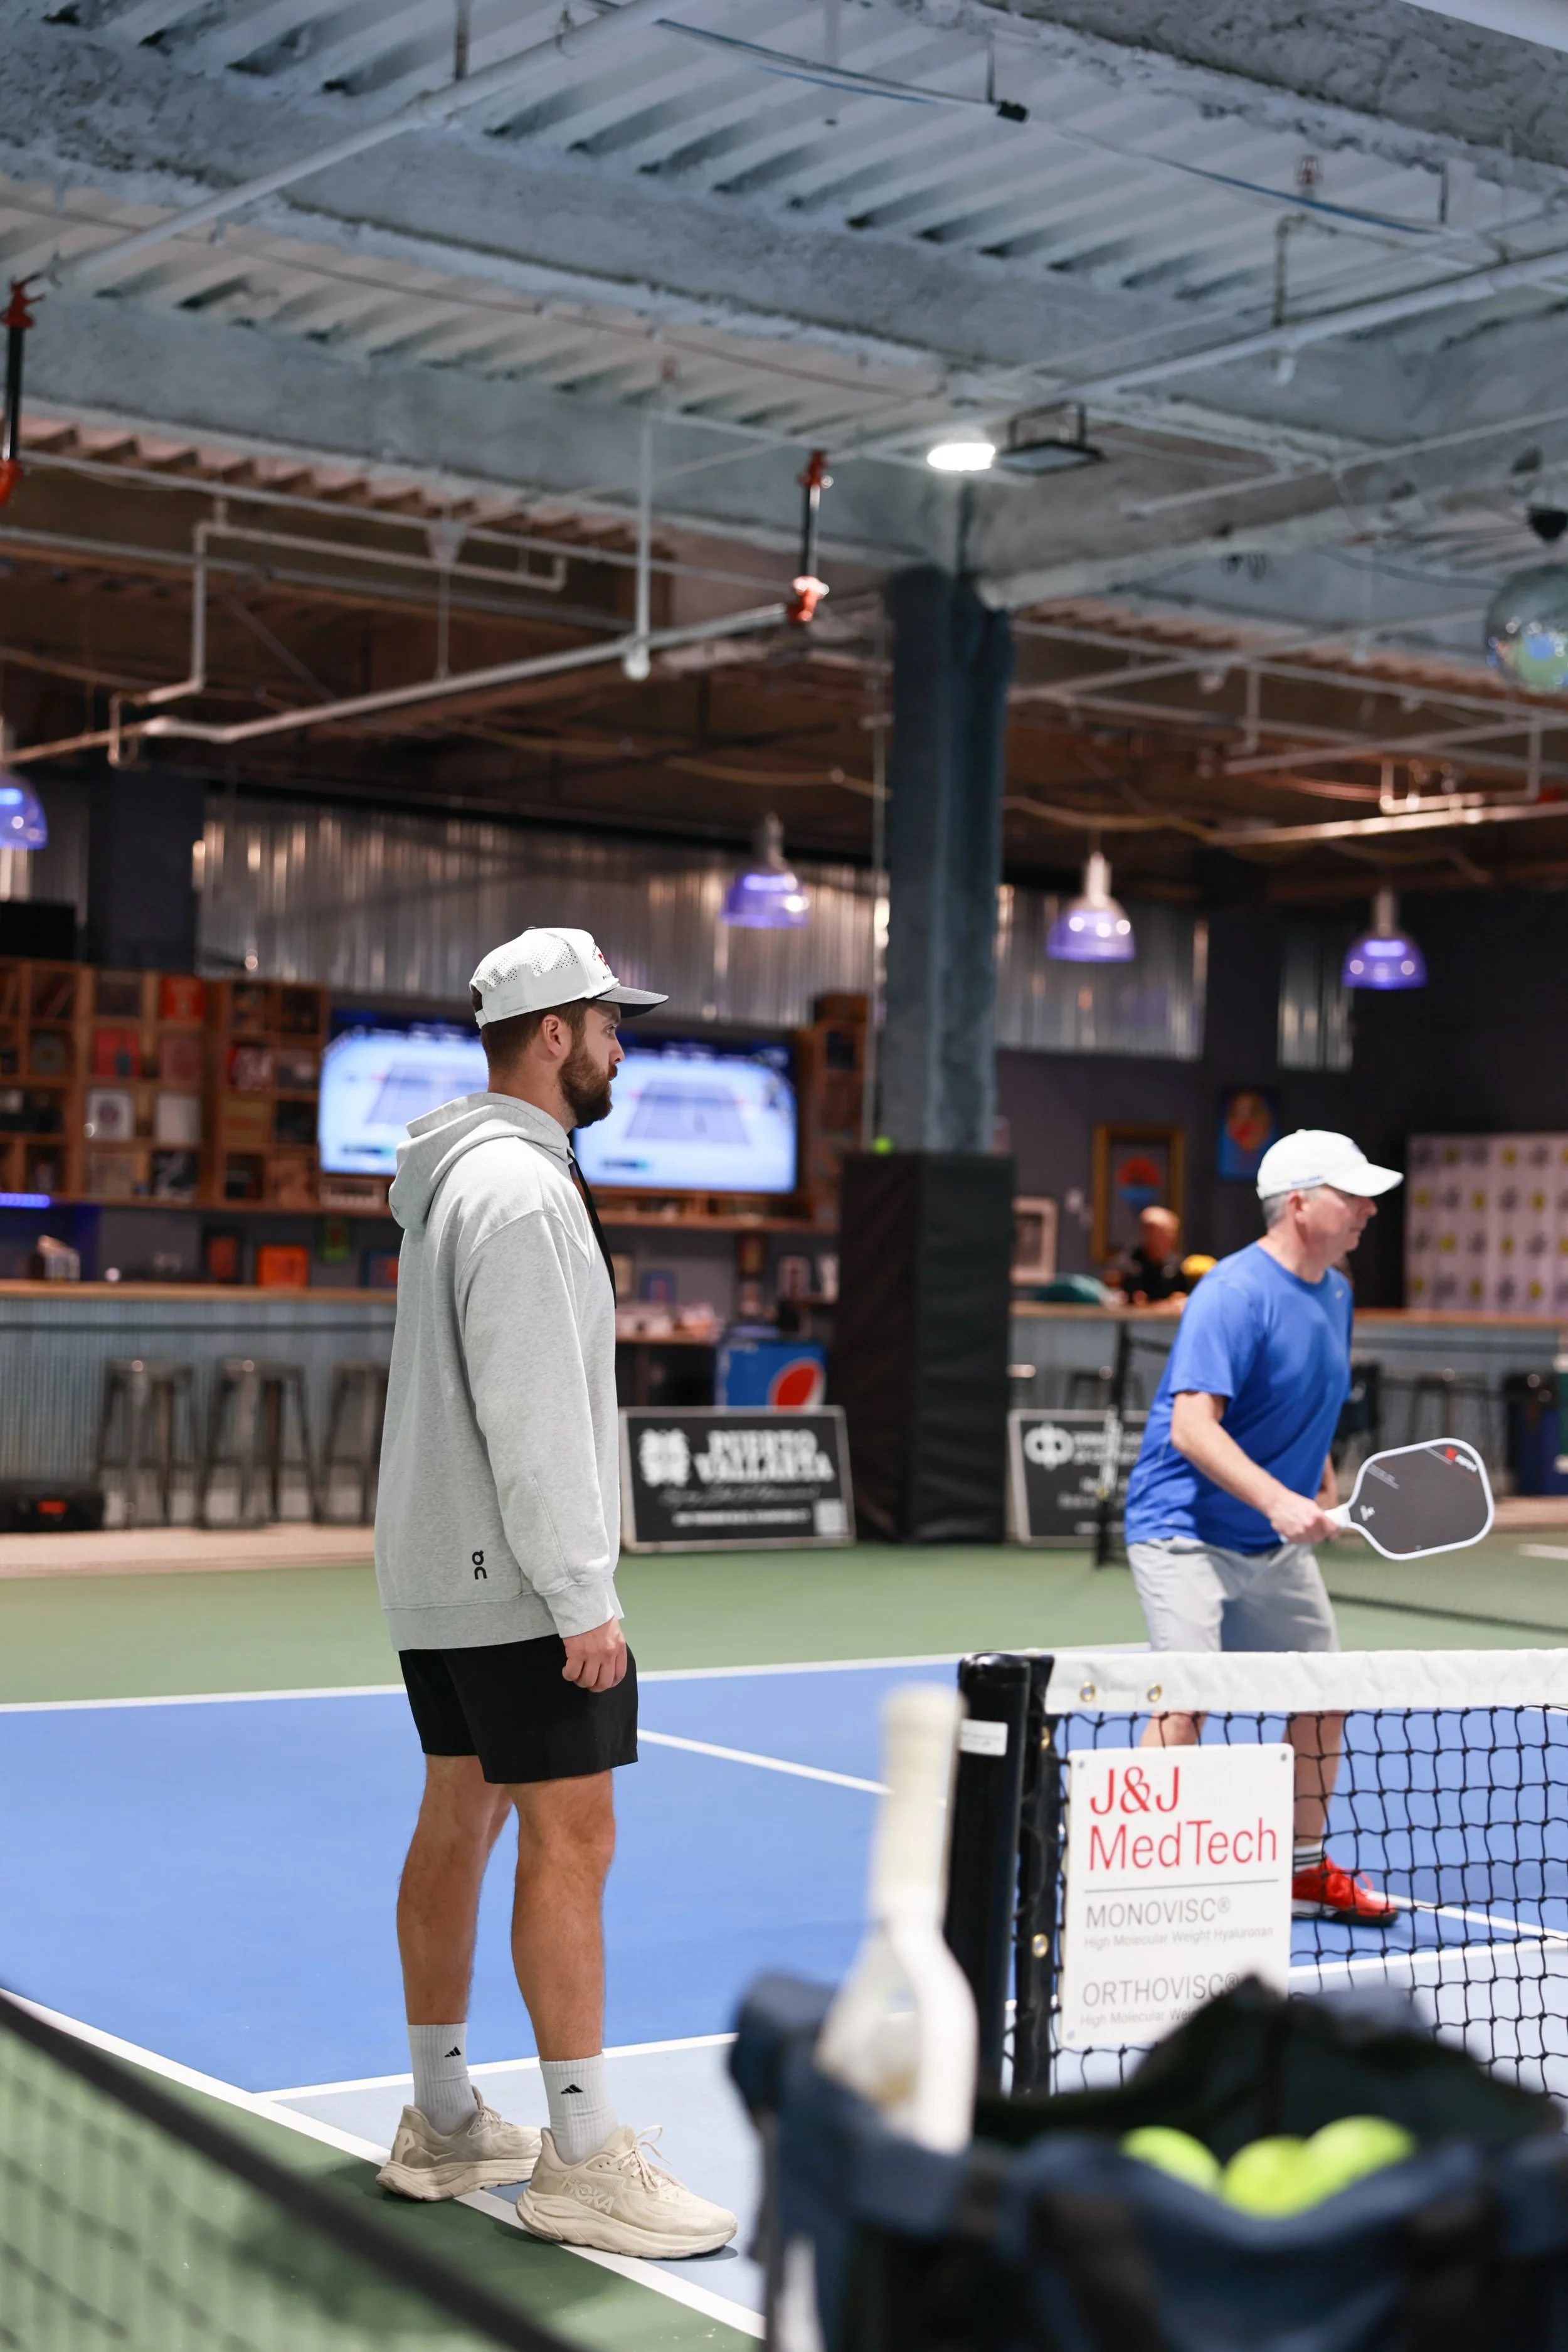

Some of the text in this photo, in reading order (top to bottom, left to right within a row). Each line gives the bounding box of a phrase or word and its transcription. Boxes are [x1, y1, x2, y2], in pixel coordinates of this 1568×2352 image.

[1089, 1766, 1180, 1815] J&J
[1089, 1817, 1277, 1872] MedTech
[1084, 1926, 1273, 1951] High Molecular Weight Hyaluronan
[1080, 2014, 1107, 2028] High
[1110, 2011, 1165, 2026] Molecular
[559, 2175, 615, 2215] HOKA
